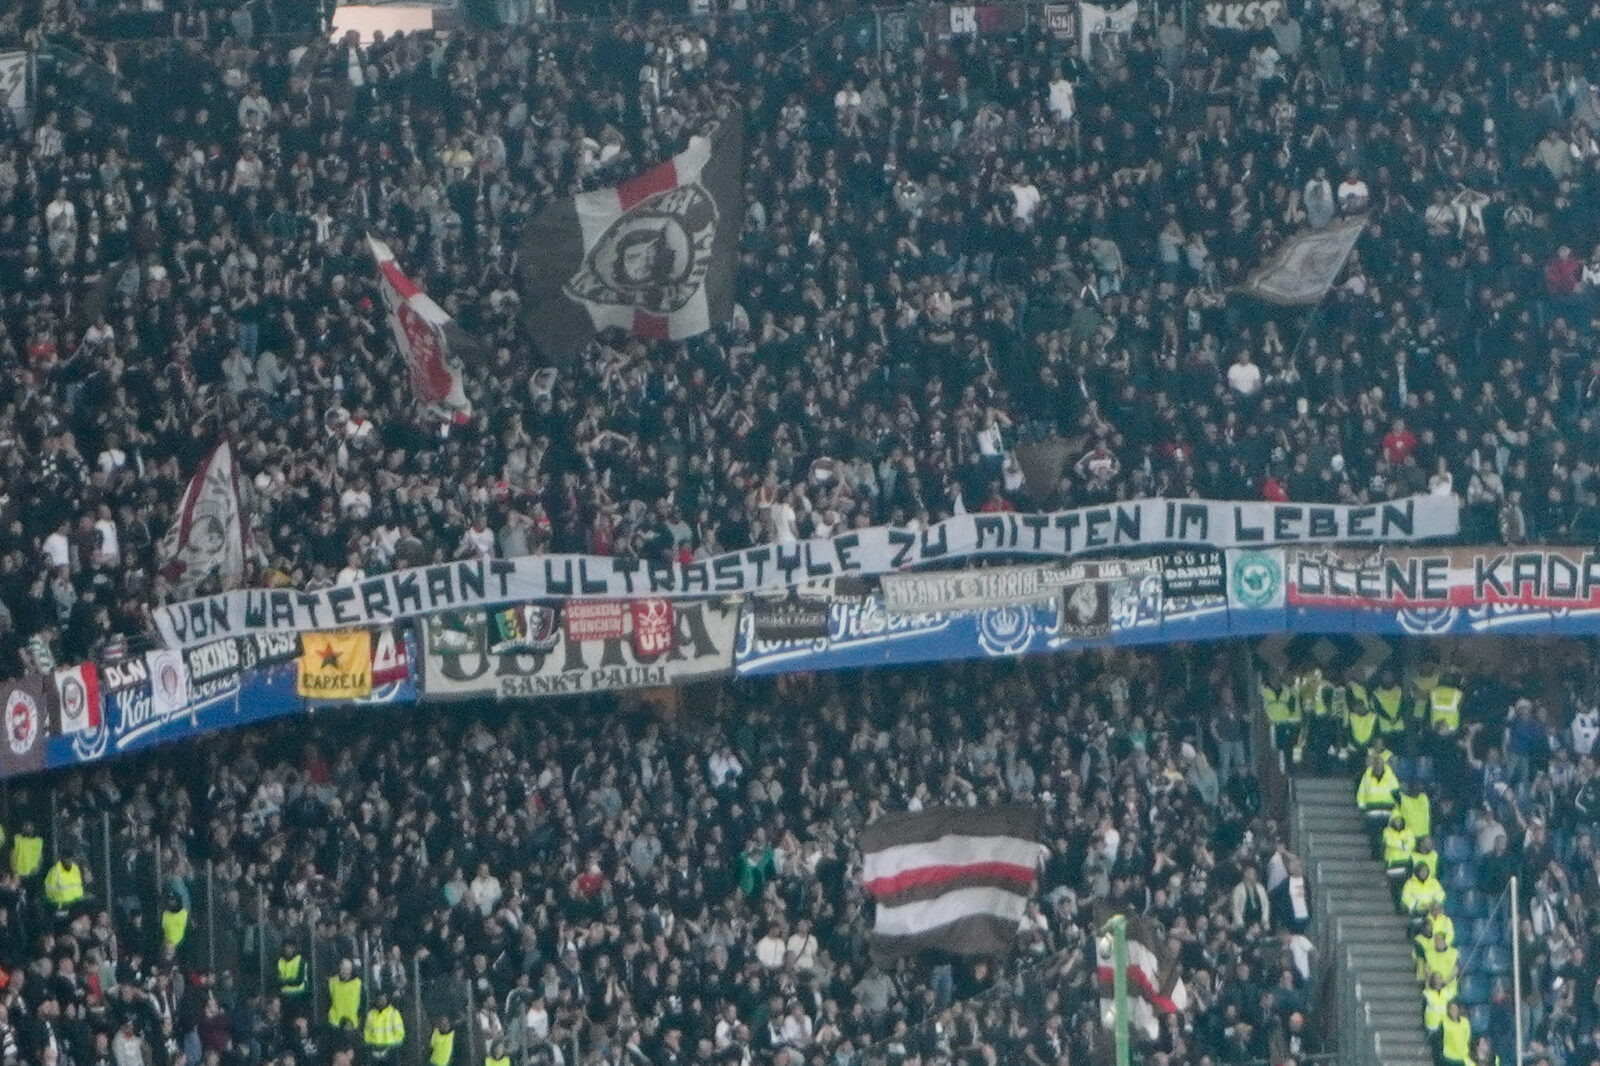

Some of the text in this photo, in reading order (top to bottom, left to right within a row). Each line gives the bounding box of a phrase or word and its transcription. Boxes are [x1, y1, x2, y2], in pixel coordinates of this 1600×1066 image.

[171, 499, 1414, 643] VON WATERKANT ULTRASTYLE ZU MITTEN IM LEBEN
[190, 637, 239, 679] SKINS
[502, 665, 667, 695] SANKT PAULI
